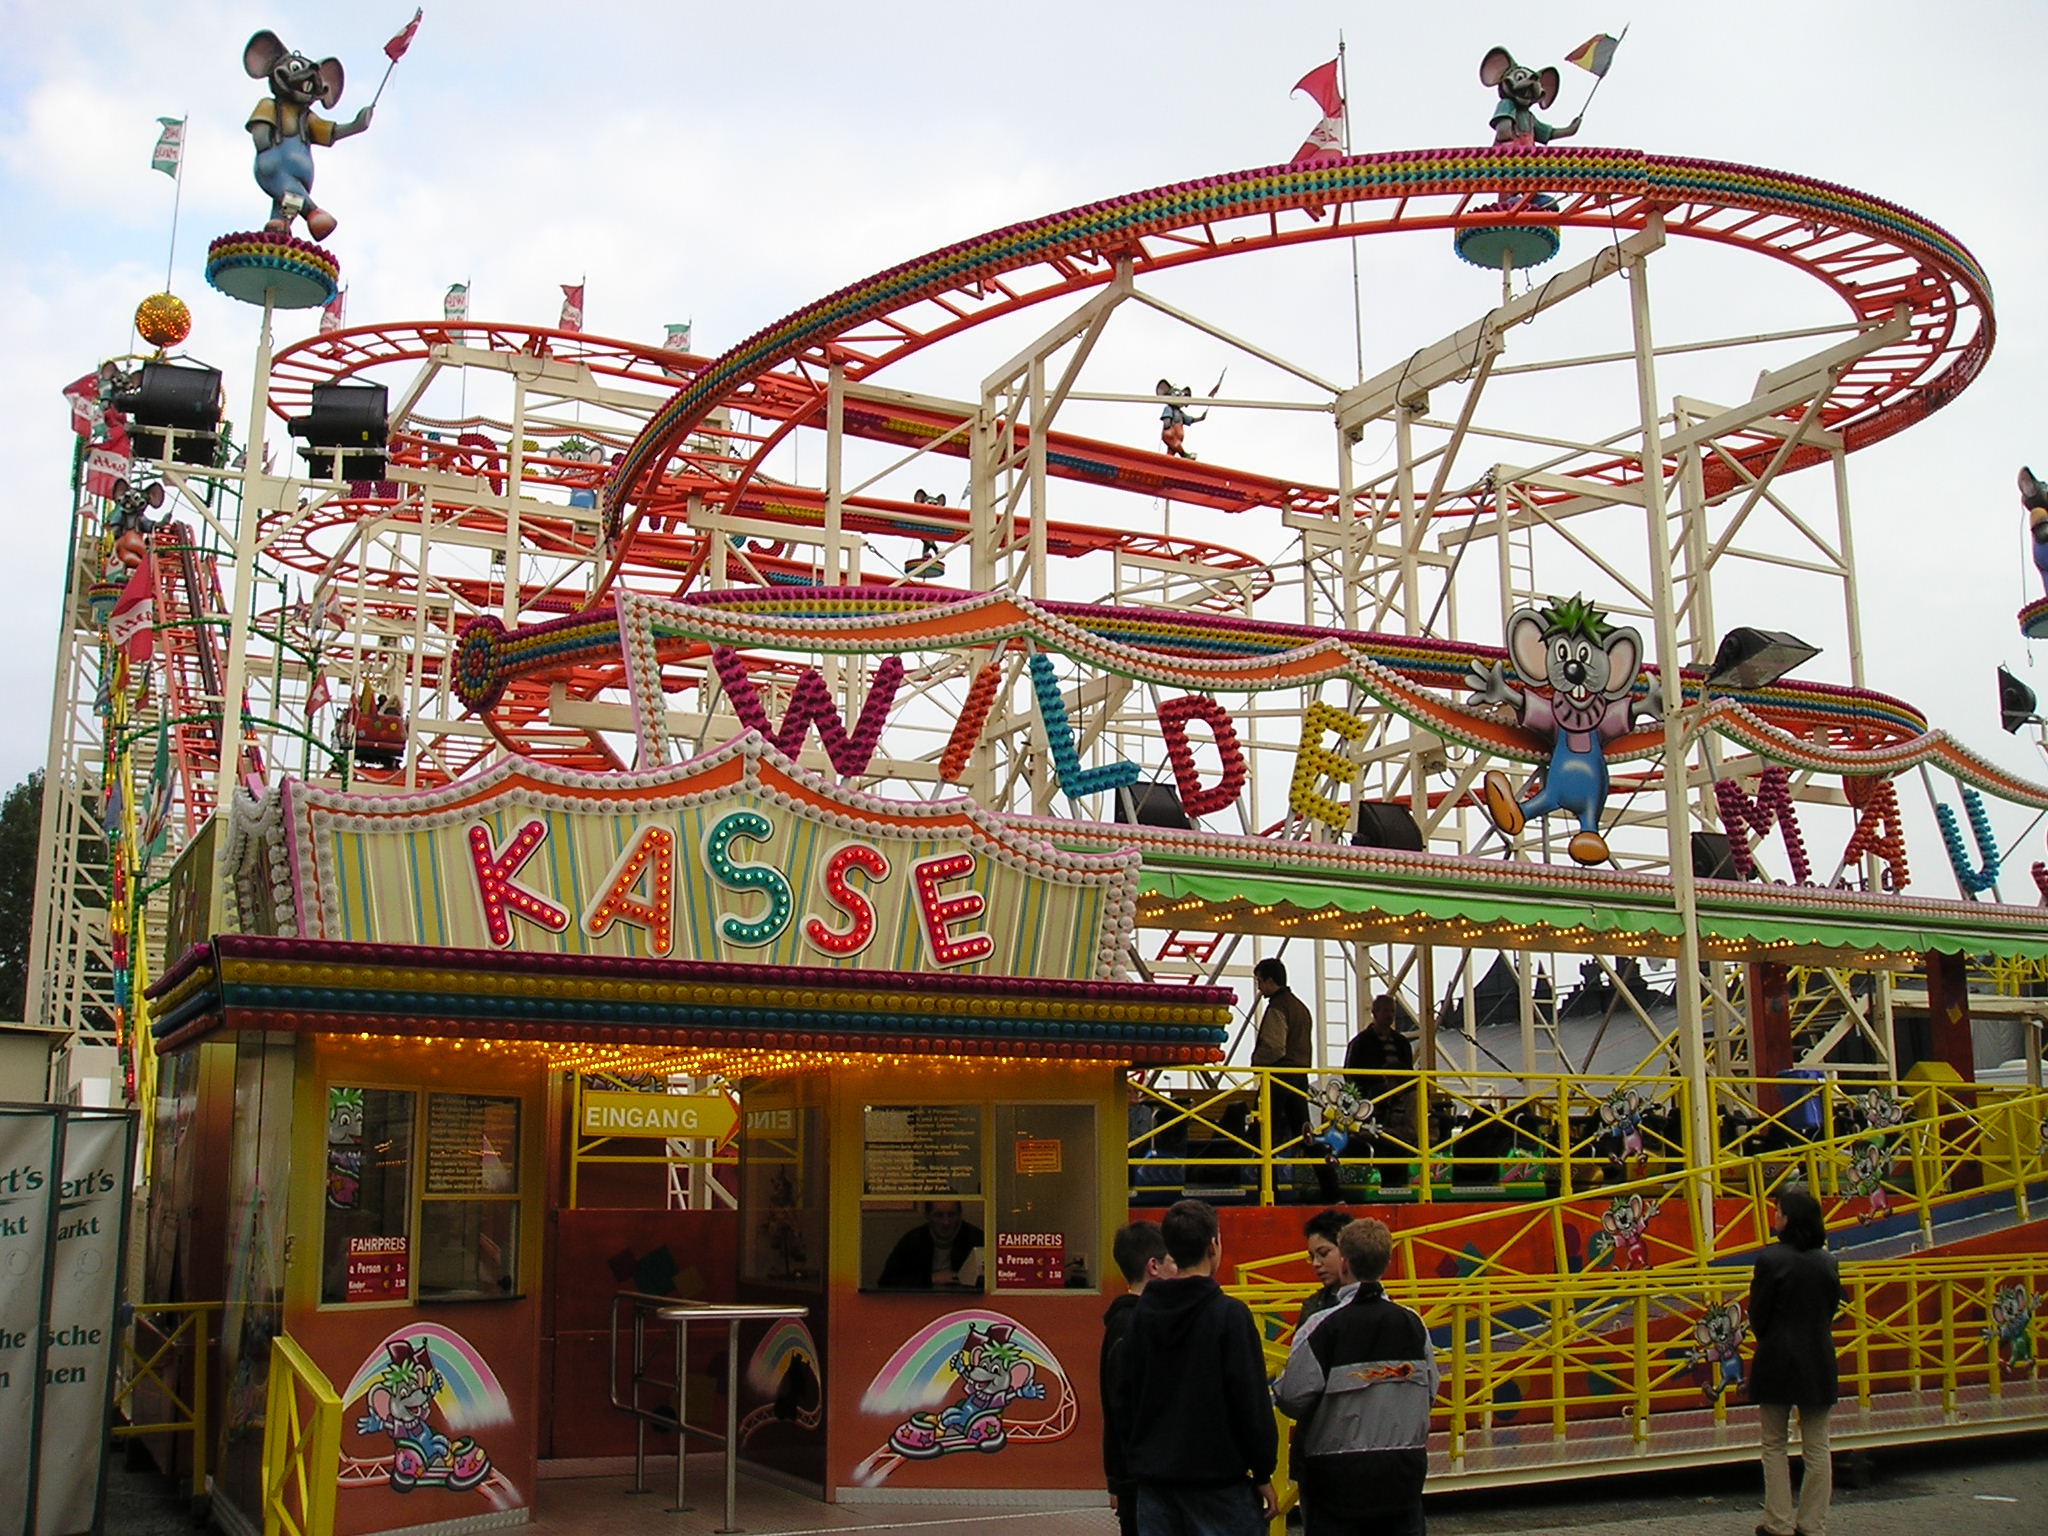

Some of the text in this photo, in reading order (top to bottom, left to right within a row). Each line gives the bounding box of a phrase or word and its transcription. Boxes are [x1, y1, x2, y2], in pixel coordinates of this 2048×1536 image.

[711, 645, 1371, 829] WILDE
[465, 806, 994, 968] KASSE
[585, 1106, 698, 1129] EINGANG
[351, 1237, 406, 1251] FAHRPREIS
[998, 1233, 1062, 1246] FAHRPREIS
[1006, 1255, 1034, 1265] Person
[357, 1262, 381, 1274] Person
